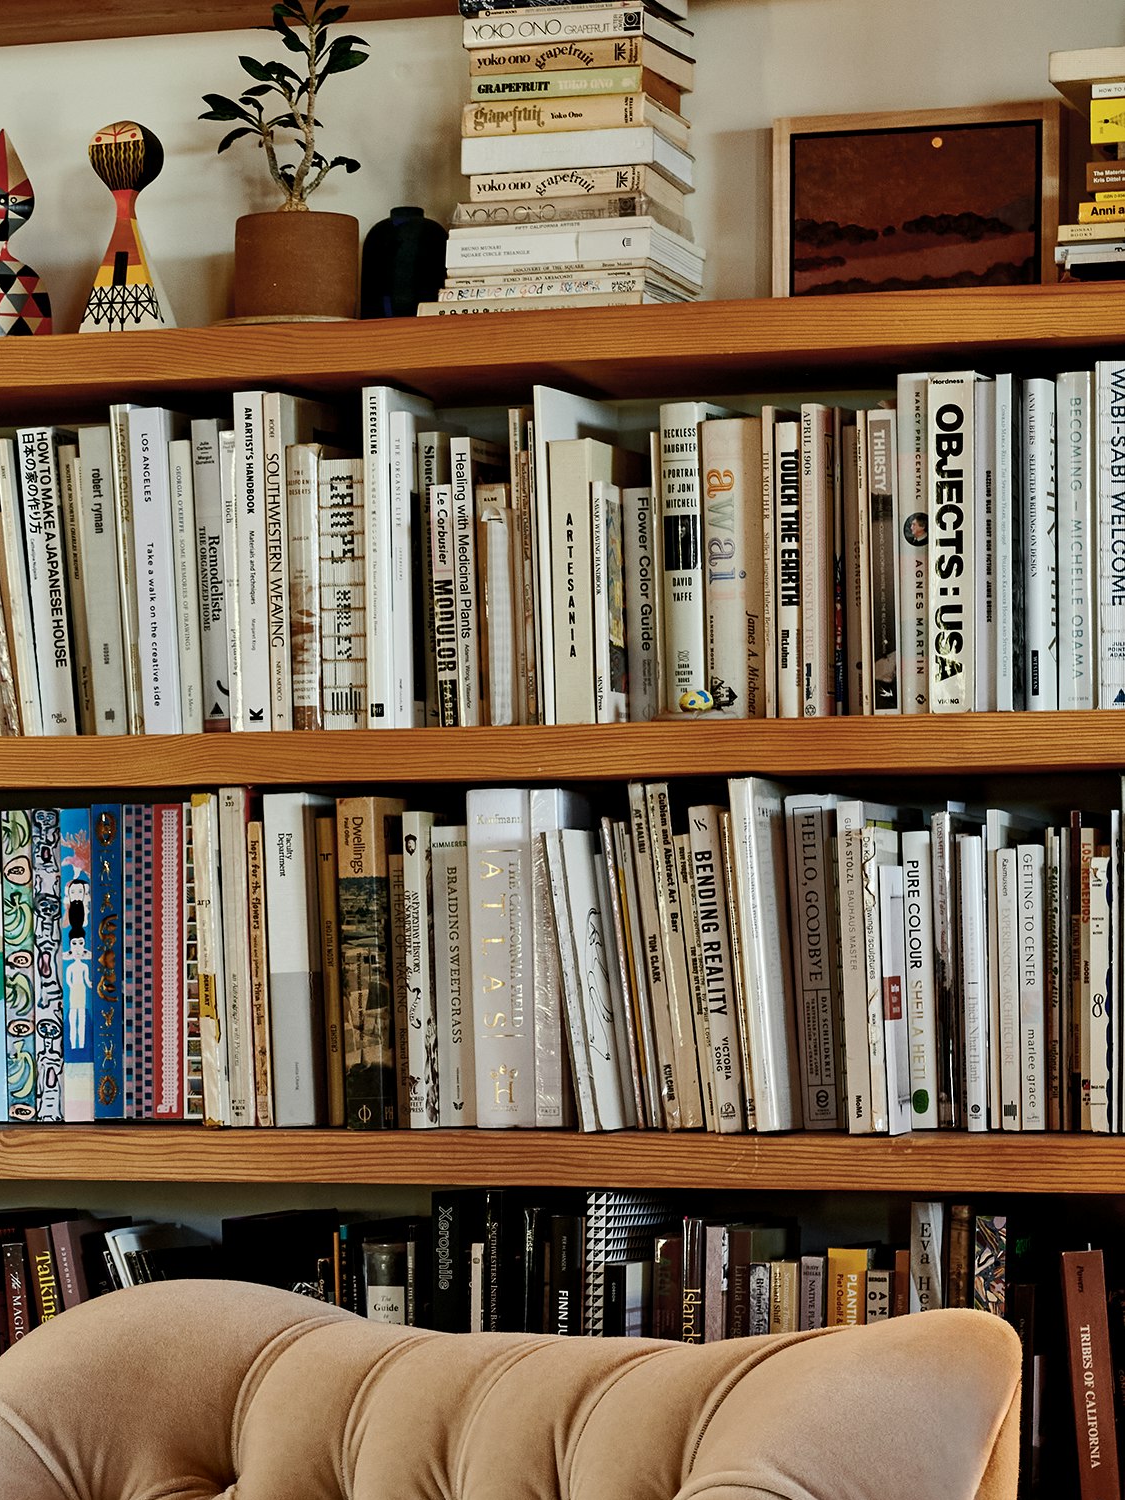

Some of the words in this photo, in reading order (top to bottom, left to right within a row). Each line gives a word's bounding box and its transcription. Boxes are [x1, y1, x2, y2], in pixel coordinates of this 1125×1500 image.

[472, 21, 514, 42] YOKO
[519, 19, 561, 38] ONO
[564, 22, 610, 35] GRAPEFRUIT
[477, 56, 506, 68] yoko
[509, 53, 530, 64] ono
[535, 43, 594, 70] grapefruit
[477, 81, 550, 94] GRAPEFRUIT
[474, 106, 545, 132] grapefruit
[477, 183, 506, 195] yoko
[509, 180, 531, 191] ono
[535, 172, 595, 197] grapefruit
[1091, 206, 1115, 216] Anni
[245, 408, 253, 420] AN
[803, 411, 811, 447] APRIL
[1110, 368, 1125, 485] WABI-SABI
[36, 432, 50, 463] HOW
[141, 433, 149, 452] LOS
[245, 422, 254, 460] ARTIST'S
[803, 450, 811, 476] 1908
[873, 429, 887, 491] THIRSTY
[1069, 397, 1082, 492] BECOMING
[22, 433, 42, 535] 日本の家の作り方
[39, 466, 51, 485] TO
[92, 468, 103, 498] robert
[143, 456, 152, 503] ANGELES
[246, 463, 255, 514] HANDBOOK
[454, 452, 467, 501] Healing
[780, 449, 799, 506] TOUCH
[41, 488, 55, 530] MAKE
[91, 502, 104, 534] ryman
[266, 453, 282, 572] SOUTHWESTERN
[437, 492, 447, 506] Le
[458, 504, 469, 531] with
[44, 533, 55, 542] A
[437, 508, 450, 565] Corbusier
[638, 497, 649, 551] Flower
[781, 509, 800, 543] THE
[458, 535, 471, 594] Medicinal
[1071, 519, 1084, 606] MICHELLE
[1110, 492, 1125, 607] WELCOME
[45, 544, 63, 616] JAPANESE
[207, 534, 224, 623] Remodelista
[565, 512, 577, 658] ARTESANIA
[639, 555, 651, 599] Color
[781, 548, 800, 607] EARTH
[914, 560, 923, 610] AGNES
[270, 579, 284, 648] WEAVING
[434, 579, 457, 673] MODULOR
[461, 599, 472, 639] Plants
[640, 603, 653, 651] Guide
[746, 610, 759, 645] James
[52, 619, 67, 668] HOUSE
[748, 649, 759, 661] A.
[916, 615, 924, 675] MARTIN
[935, 604, 964, 683] USA
[1072, 614, 1084, 680] OBAMA
[748, 665, 760, 715] Michener
[633, 809, 641, 818] AT
[658, 793, 667, 827] Cubism
[277, 833, 286, 877] Department
[350, 816, 365, 874] Dwellings
[635, 821, 645, 853] MALIBU
[663, 829, 671, 846] and
[800, 814, 817, 887] HELLO,
[664, 847, 675, 887] Abstract
[906, 860, 919, 902] PURE
[1023, 853, 1034, 910] GETTING
[447, 867, 459, 941] BRAIDING
[668, 888, 677, 904] Art
[694, 850, 719, 934] BENDING
[480, 860, 507, 1028] ATLAS
[649, 934, 657, 953] TOM
[670, 912, 678, 933] Barr
[802, 888, 823, 982] GOODBYE
[908, 904, 923, 969] COLOUR
[1024, 914, 1034, 933] TO
[651, 955, 661, 983] CLARK
[703, 941, 728, 1016] REALITY
[1024, 936, 1035, 986] CENTER
[450, 944, 462, 1044] SWEETGRASS
[910, 980, 924, 1037] SHEILA
[715, 1046, 723, 1072] SONG
[722, 1036, 731, 1081] VICTORIA
[912, 1042, 925, 1084] HETI
[1027, 1029, 1036, 1070] marlee
[663, 1064, 675, 1102] KULCHUR
[437, 1205, 454, 1291] Xerophile
[919, 1222, 932, 1265] Eva
[34, 1251, 57, 1325] Talking
[60, 1247, 73, 1294] ABUNDANCE
[373, 1303, 399, 1313] Guide
[558, 1290, 570, 1321] FINN
[1079, 1324, 1094, 1369] TRIBES
[1083, 1371, 1096, 1388] OF
[1084, 1390, 1102, 1469] CALIFORNIA
